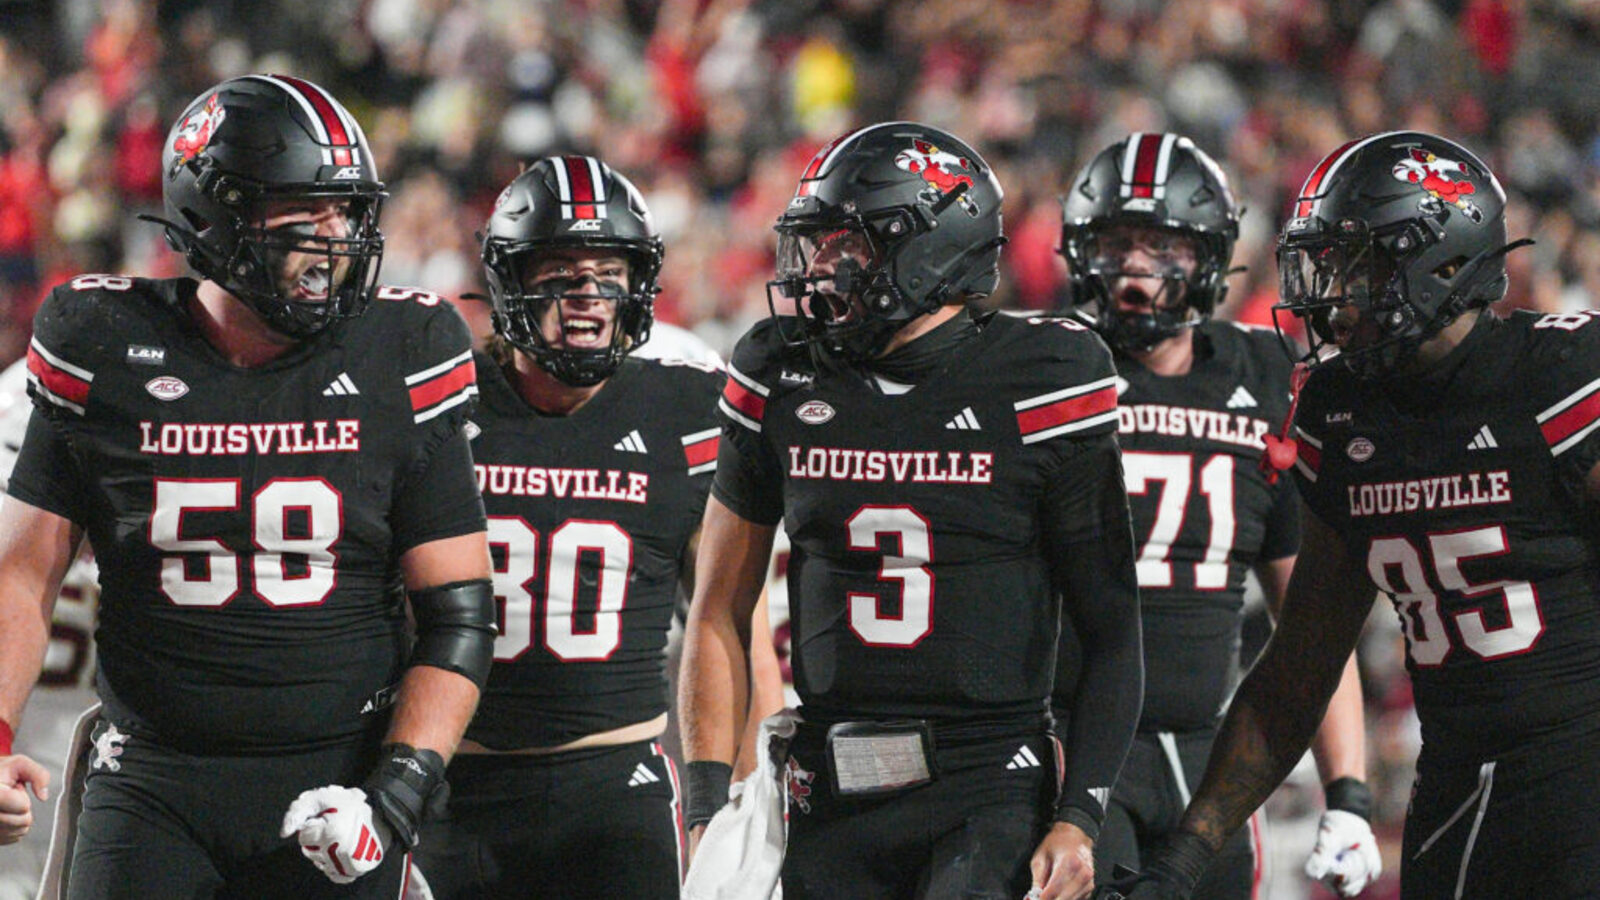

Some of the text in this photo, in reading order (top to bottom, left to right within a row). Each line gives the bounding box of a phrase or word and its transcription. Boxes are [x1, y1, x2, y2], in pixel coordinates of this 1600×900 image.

[1533, 309, 1600, 332] 8
[139, 419, 360, 454] LOUISVILLE
[1118, 404, 1269, 450] OUISVILLE
[474, 464, 648, 503] UISVILLE
[788, 446, 993, 483] LOUISVILLE
[1347, 470, 1512, 516] LOUISVILLE
[147, 476, 344, 608] 58
[1121, 450, 1236, 591] 71
[844, 504, 935, 648] 3
[1366, 521, 1546, 669] 85
